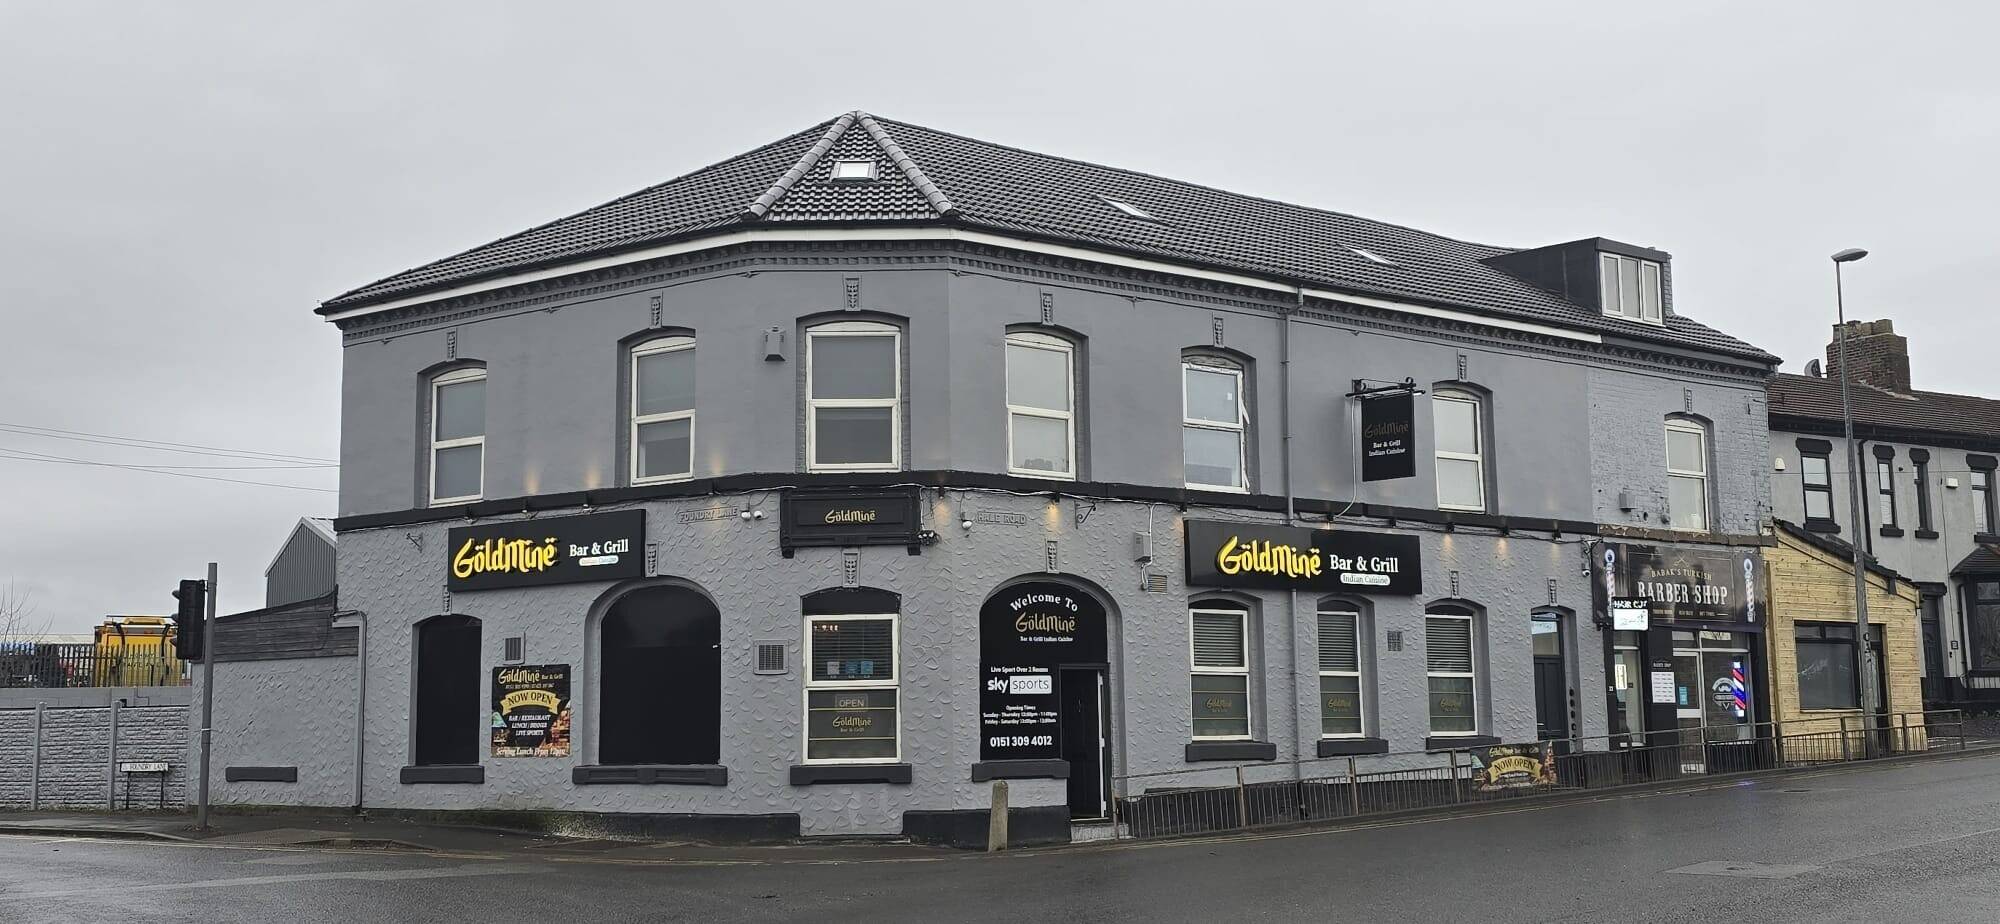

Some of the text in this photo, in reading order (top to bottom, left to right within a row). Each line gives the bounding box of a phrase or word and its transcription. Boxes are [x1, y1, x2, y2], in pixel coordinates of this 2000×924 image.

[679, 511, 713, 522] FOUNDRY
[569, 544, 588, 557] Bar
[591, 542, 601, 555] &
[604, 538, 629, 554] Grill
[1330, 554, 1353, 570] Bar
[1356, 556, 1368, 572] &
[1370, 556, 1399, 573] Grill
[1343, 575, 1364, 583] Indian
[1651, 568, 1712, 580] BABAK'S TURKISH
[1637, 581, 1728, 605] BARBER SHOP
[1010, 594, 1078, 612] Welcome To
[987, 677, 1049, 694] sky sports
[508, 692, 553, 705] NOW OPEN
[839, 699, 864, 707] OPEN
[990, 736, 1052, 747] 0151 309 4012
[517, 747, 533, 755] Lunch
[1494, 759, 1535, 773] NOW OPEN
